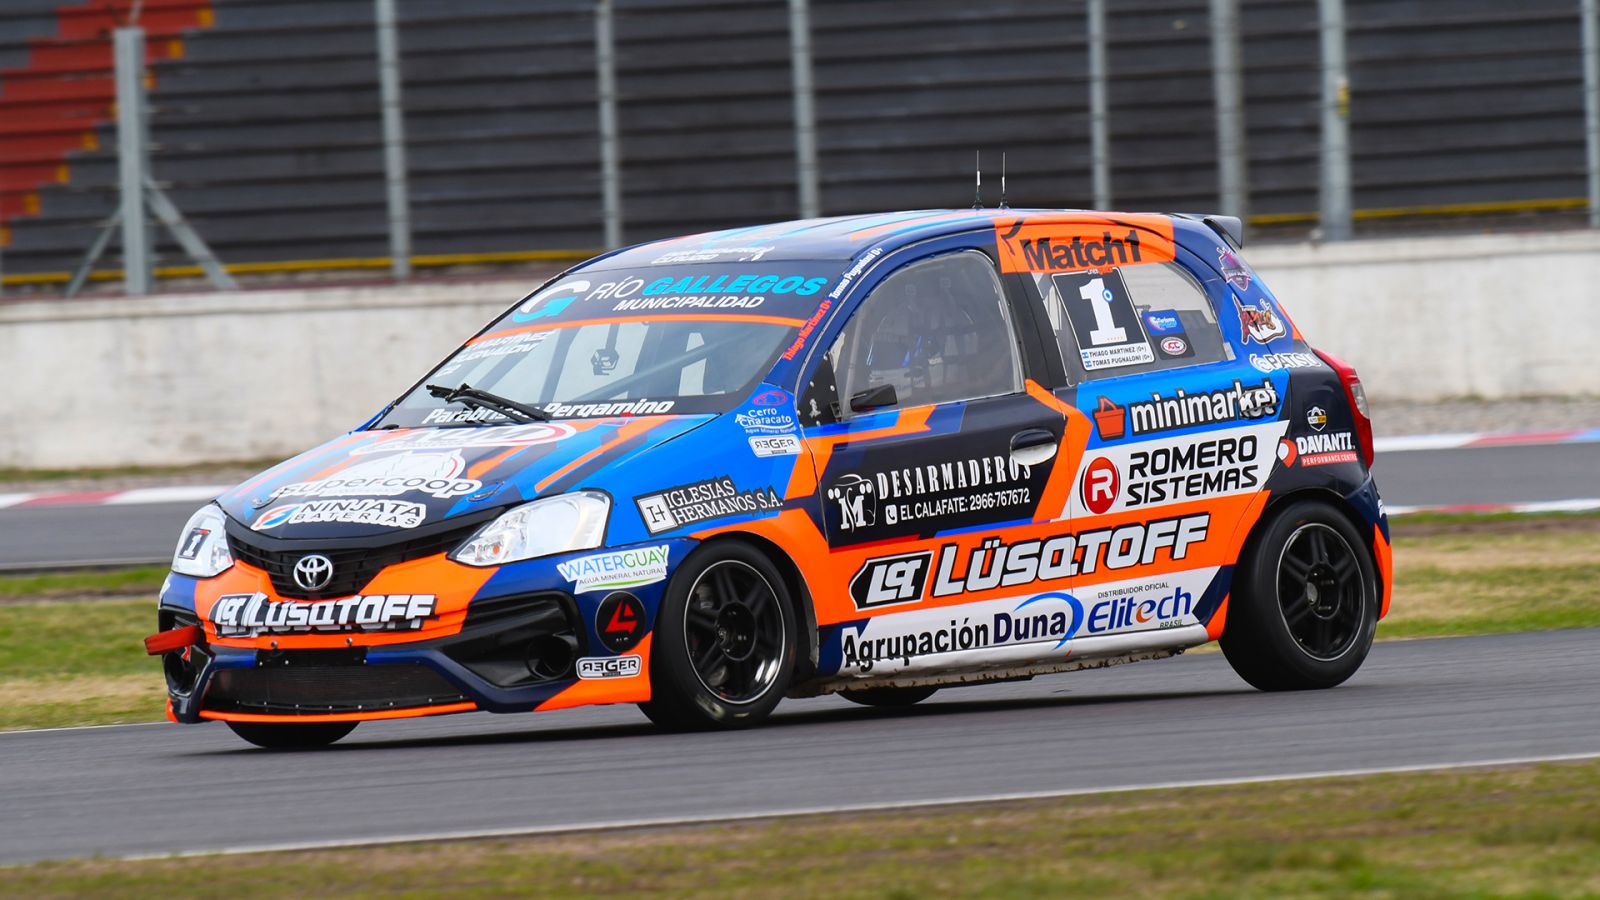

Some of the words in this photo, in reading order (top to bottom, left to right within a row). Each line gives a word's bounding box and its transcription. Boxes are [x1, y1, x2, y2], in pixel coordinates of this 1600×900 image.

[1020, 230, 1141, 271] Match1
[585, 276, 643, 301] RÍO
[642, 275, 827, 296] GALLEGOS
[613, 295, 766, 312] MUNICIPALIDAD
[1079, 277, 1128, 346] 1
[782, 335, 805, 361] Thiago
[1089, 349, 1109, 358] THIAGO
[1109, 347, 1136, 356] MARTINEZ
[1092, 359, 1111, 367] TOMAS
[544, 399, 675, 418] Pergamino
[748, 407, 777, 418] Cerro
[1130, 381, 1279, 433] minimarket
[739, 414, 792, 427] Characato
[1296, 432, 1352, 456] DAVANTI
[1128, 435, 1258, 480] ROMERO
[281, 478, 477, 497] supercoop
[876, 455, 1032, 500] DESARMADEROS
[1091, 468, 1115, 502] R
[1125, 465, 1259, 507] SISTEMAS
[664, 480, 736, 509] IGLESIAS
[671, 494, 757, 524] HERMANOS
[757, 491, 784, 509] S.A.
[900, 506, 914, 521] EL
[914, 496, 969, 518] CALAFATE:
[969, 487, 1031, 512] 2966-767672
[293, 511, 419, 526] BATERIAS
[300, 500, 423, 518] NINJATA
[183, 534, 202, 557] 1
[563, 548, 667, 579] WATERGUAY
[578, 576, 600, 585] AGUA
[600, 571, 633, 581] MINERAL
[632, 567, 665, 577] NATURAL
[1097, 585, 1144, 599] DISTRIBUIDOR
[1144, 581, 1170, 592] OFICIAL
[1087, 587, 1192, 634] Elitech
[1159, 619, 1184, 629] BRASIL
[843, 618, 989, 671] Agrupación
[994, 611, 1066, 644] Duna
